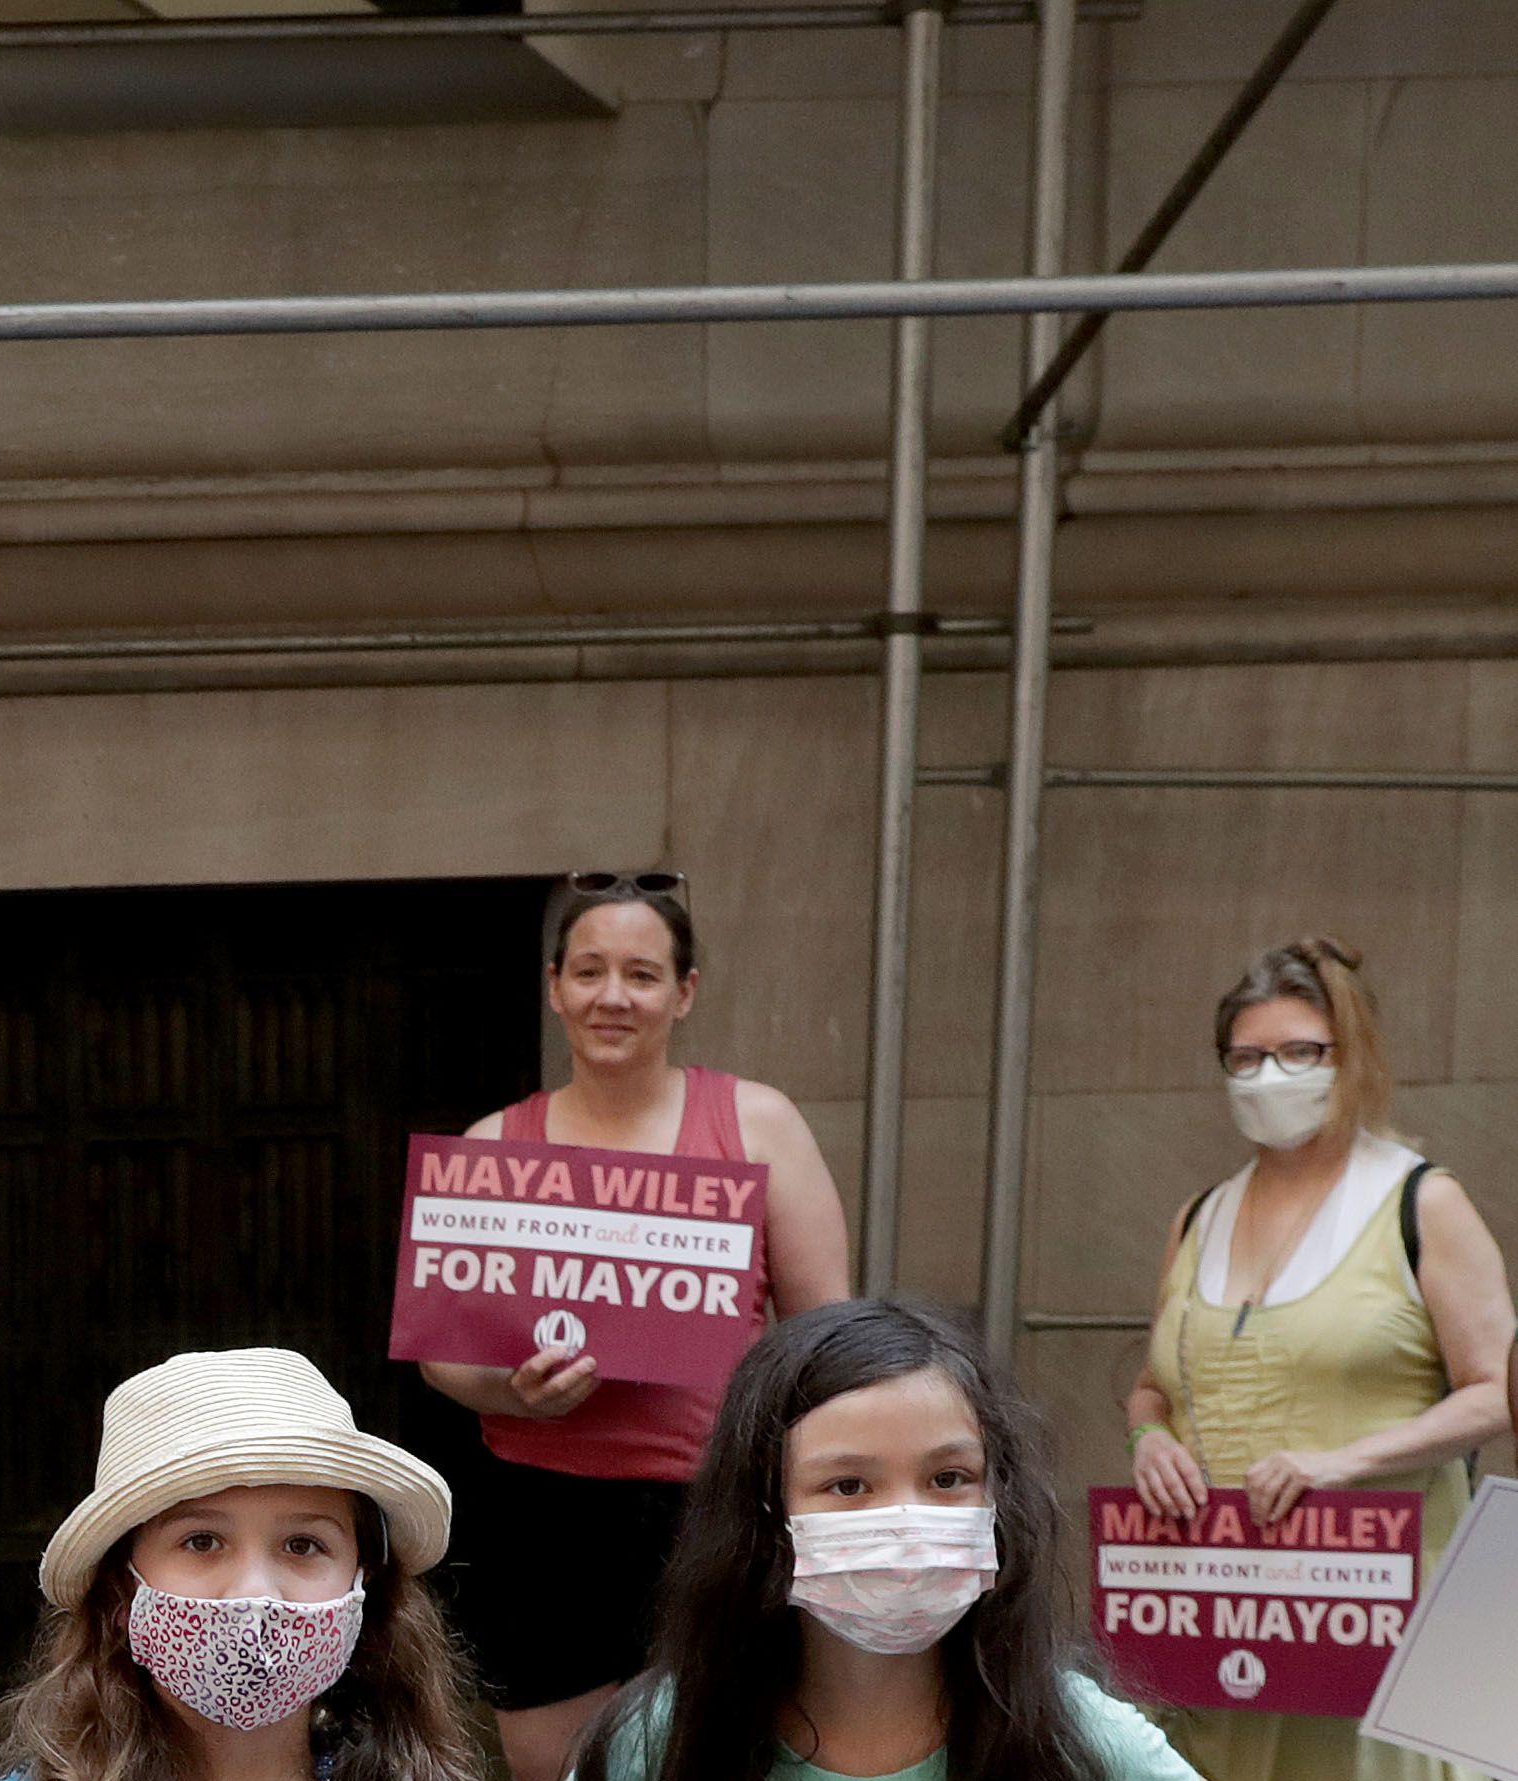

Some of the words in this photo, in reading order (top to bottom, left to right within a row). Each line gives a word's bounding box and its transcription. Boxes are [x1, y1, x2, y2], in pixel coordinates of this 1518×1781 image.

[420, 1152, 575, 1201] MAYA
[592, 1164, 757, 1219] WILEY
[421, 1213, 506, 1232] WOMEN
[517, 1217, 592, 1239] FRONT
[595, 1223, 639, 1245] and
[646, 1231, 731, 1254] CENTER
[413, 1248, 516, 1295] FOR
[532, 1255, 740, 1317] MAYOR
[1109, 1562, 1187, 1576] WOMEN
[1197, 1563, 1261, 1579] FRONT
[1311, 1567, 1392, 1584] CENTER
[1105, 1593, 1201, 1637] FOR
[1213, 1598, 1405, 1647] MAYOR
